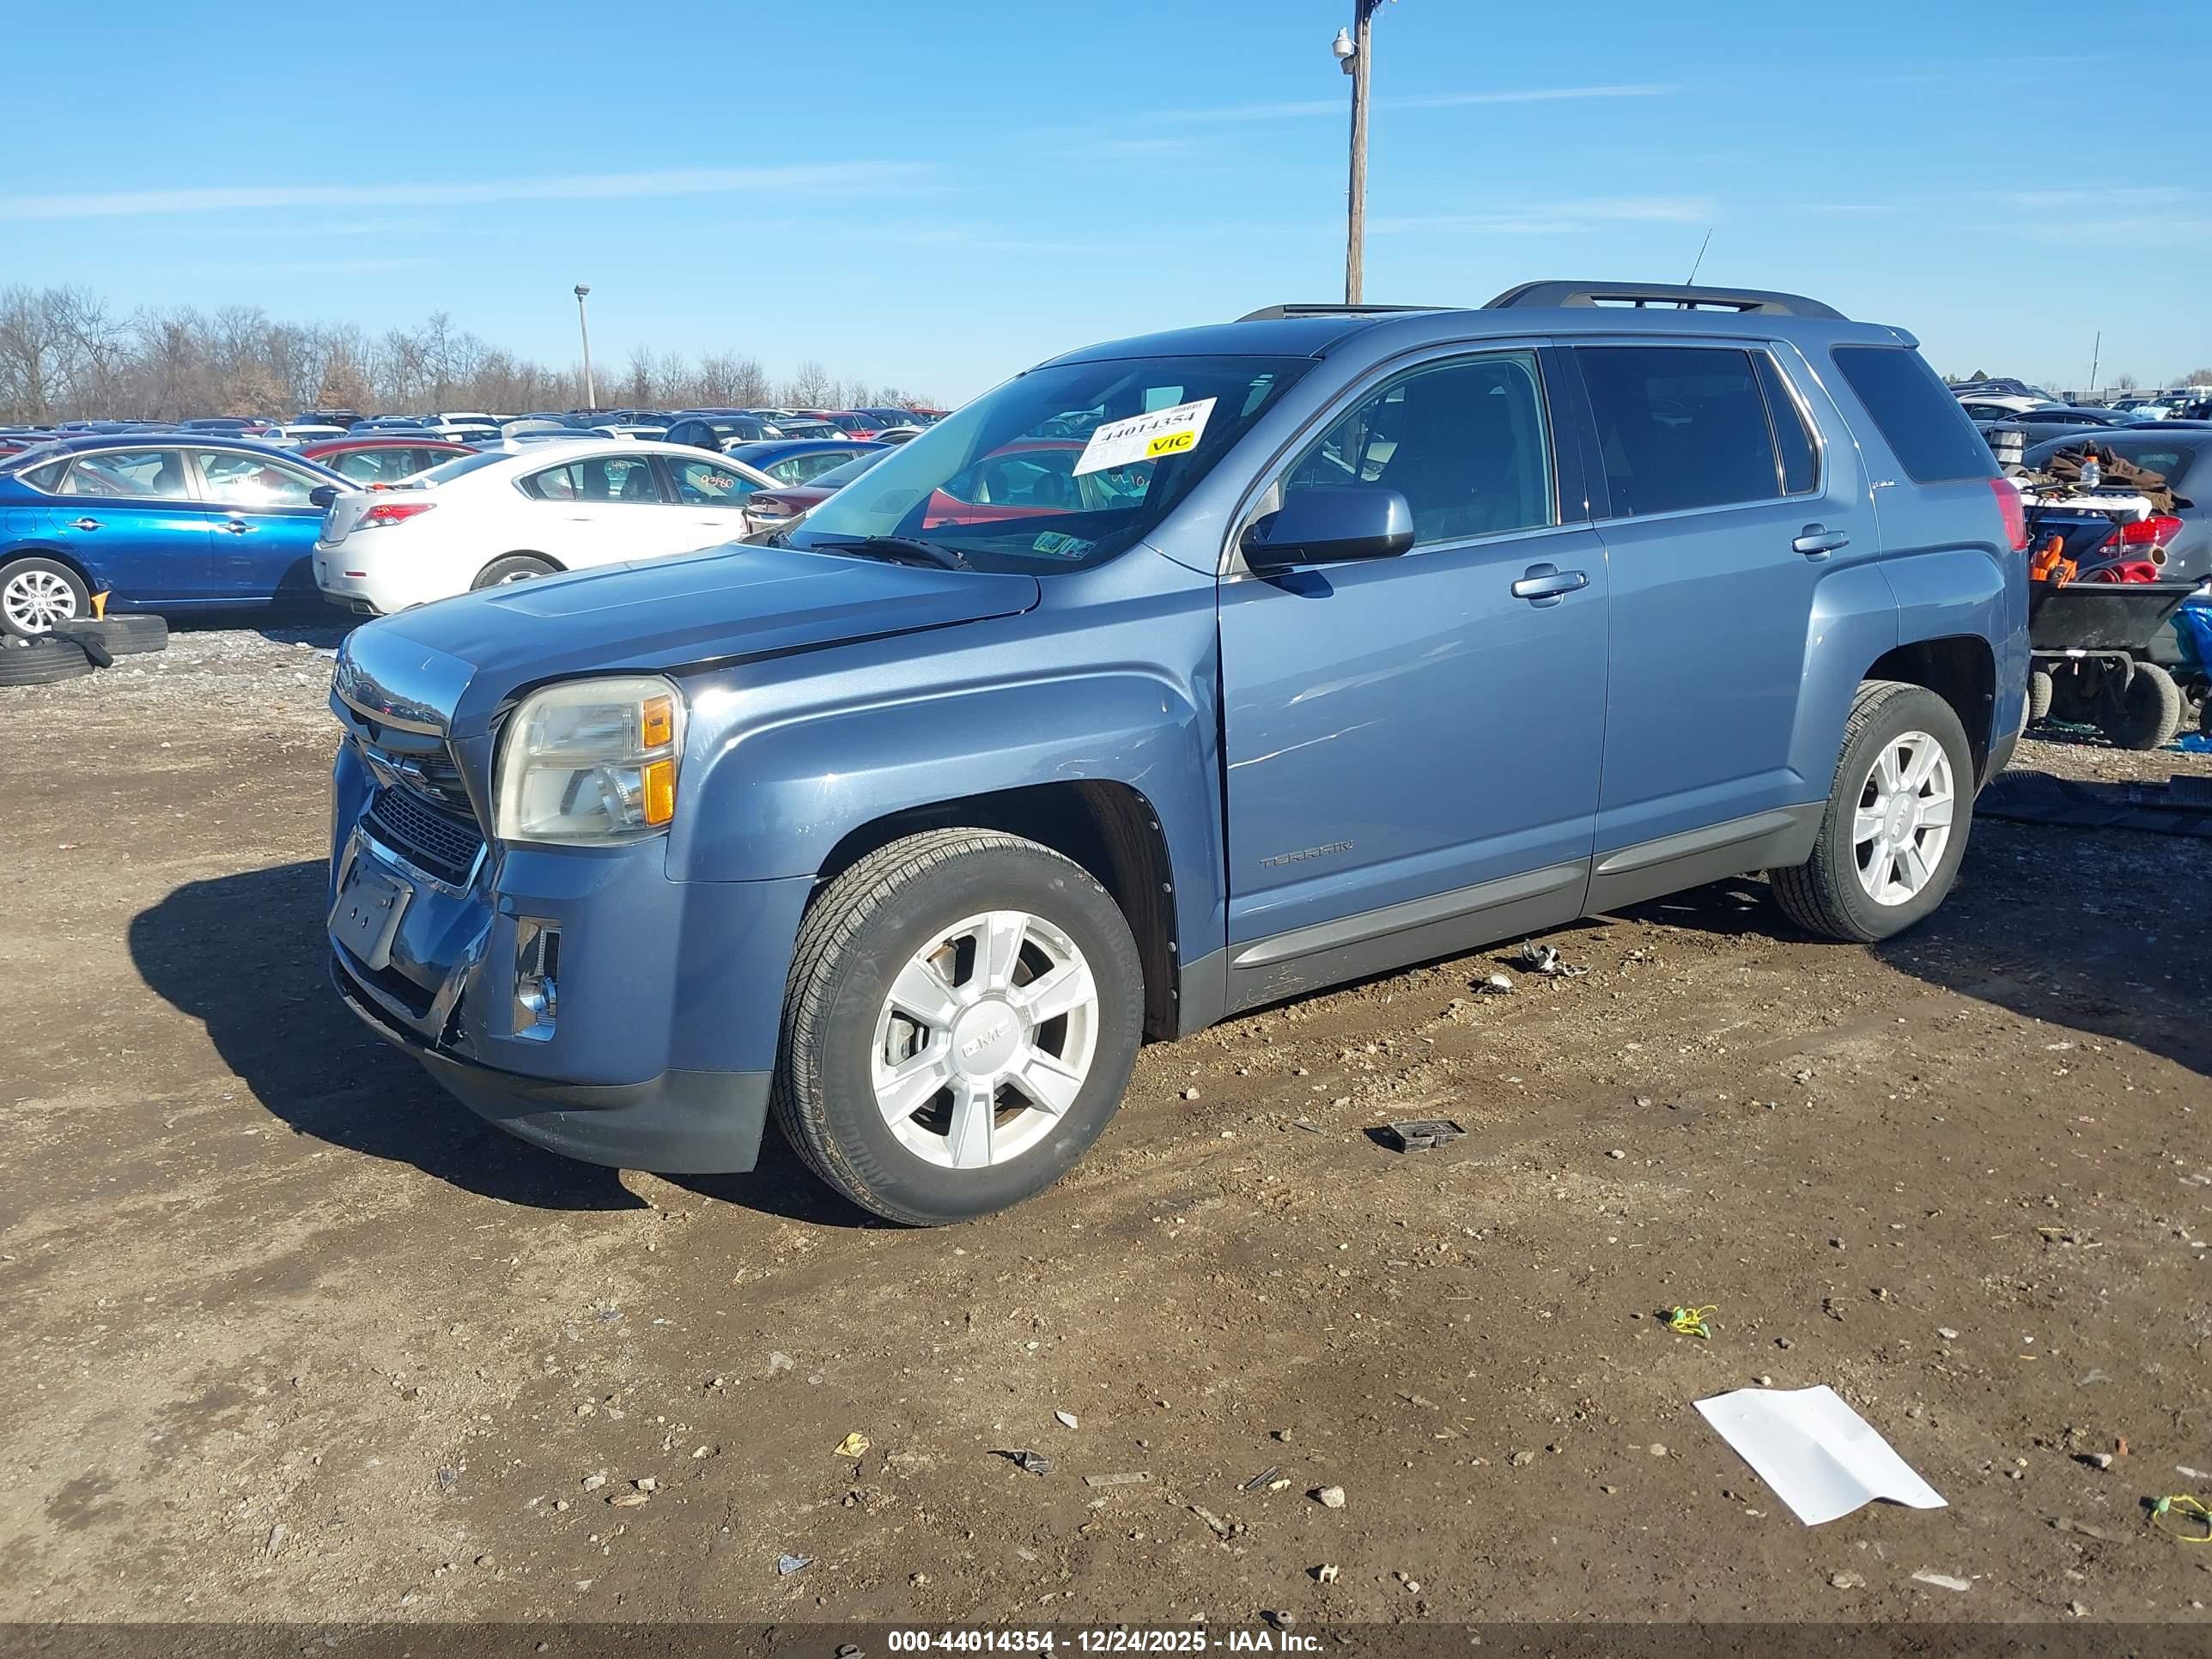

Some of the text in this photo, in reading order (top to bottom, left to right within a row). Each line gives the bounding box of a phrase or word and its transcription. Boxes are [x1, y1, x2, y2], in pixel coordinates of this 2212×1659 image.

[1100, 411, 1195, 441] 44014354
[1152, 434, 1192, 452] VIC
[700, 474, 735, 489] 9380
[1259, 839, 1354, 870] TERRAIN
[961, 1019, 1012, 1058] GMC
